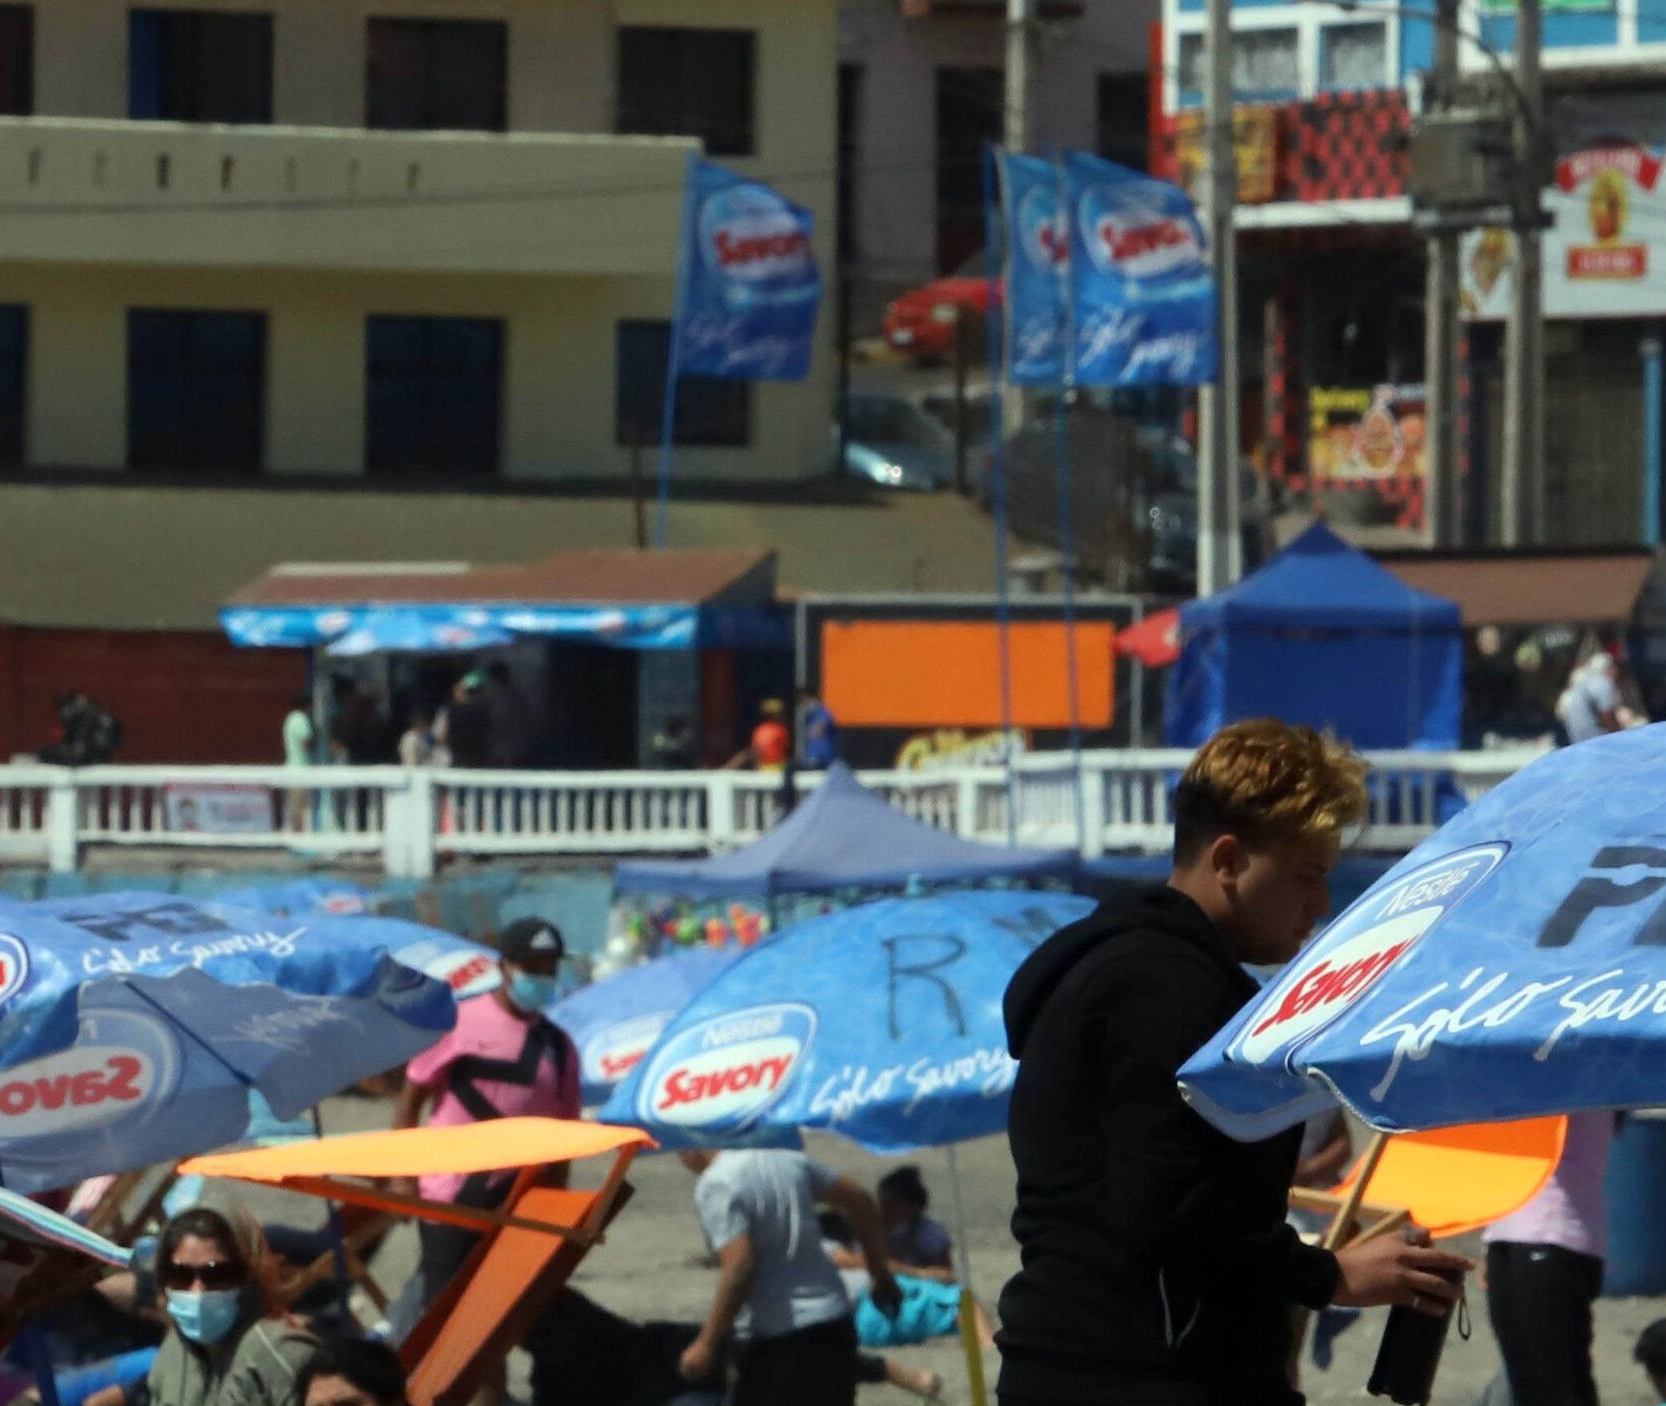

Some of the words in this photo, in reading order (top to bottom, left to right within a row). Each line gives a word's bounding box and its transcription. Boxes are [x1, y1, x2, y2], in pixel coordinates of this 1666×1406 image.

[880, 933, 967, 1040] R
[658, 1053, 793, 1112] Savory
[904, 1046, 1023, 1119] Savory
